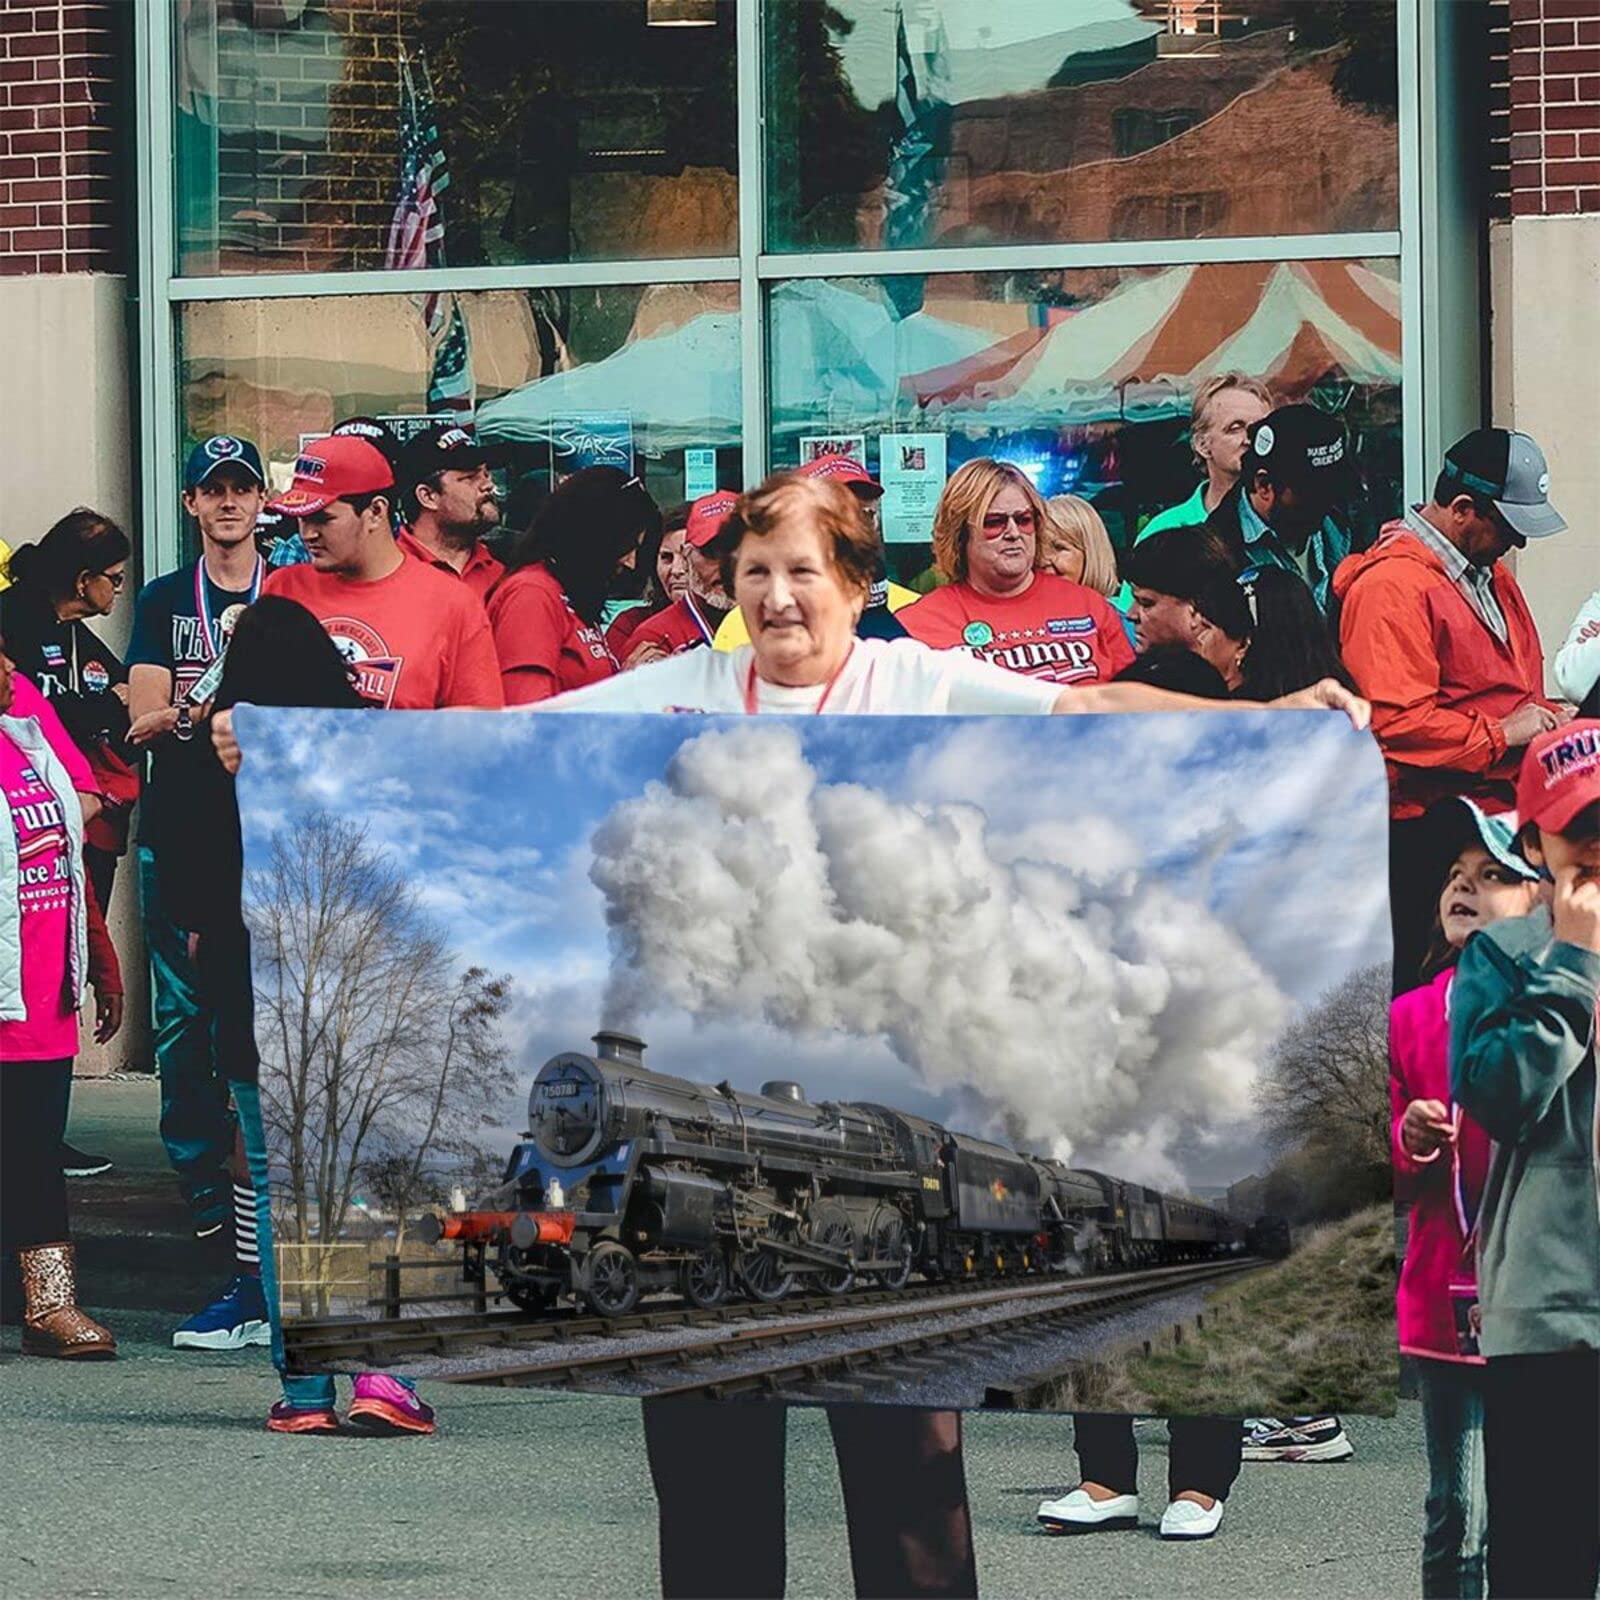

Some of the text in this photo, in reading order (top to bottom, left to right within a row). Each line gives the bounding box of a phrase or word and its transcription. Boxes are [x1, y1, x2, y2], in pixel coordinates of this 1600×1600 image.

[334, 422, 384, 438] TRUMP
[555, 428, 629, 460] STARZ
[20, 888, 59, 900] AMERICA
